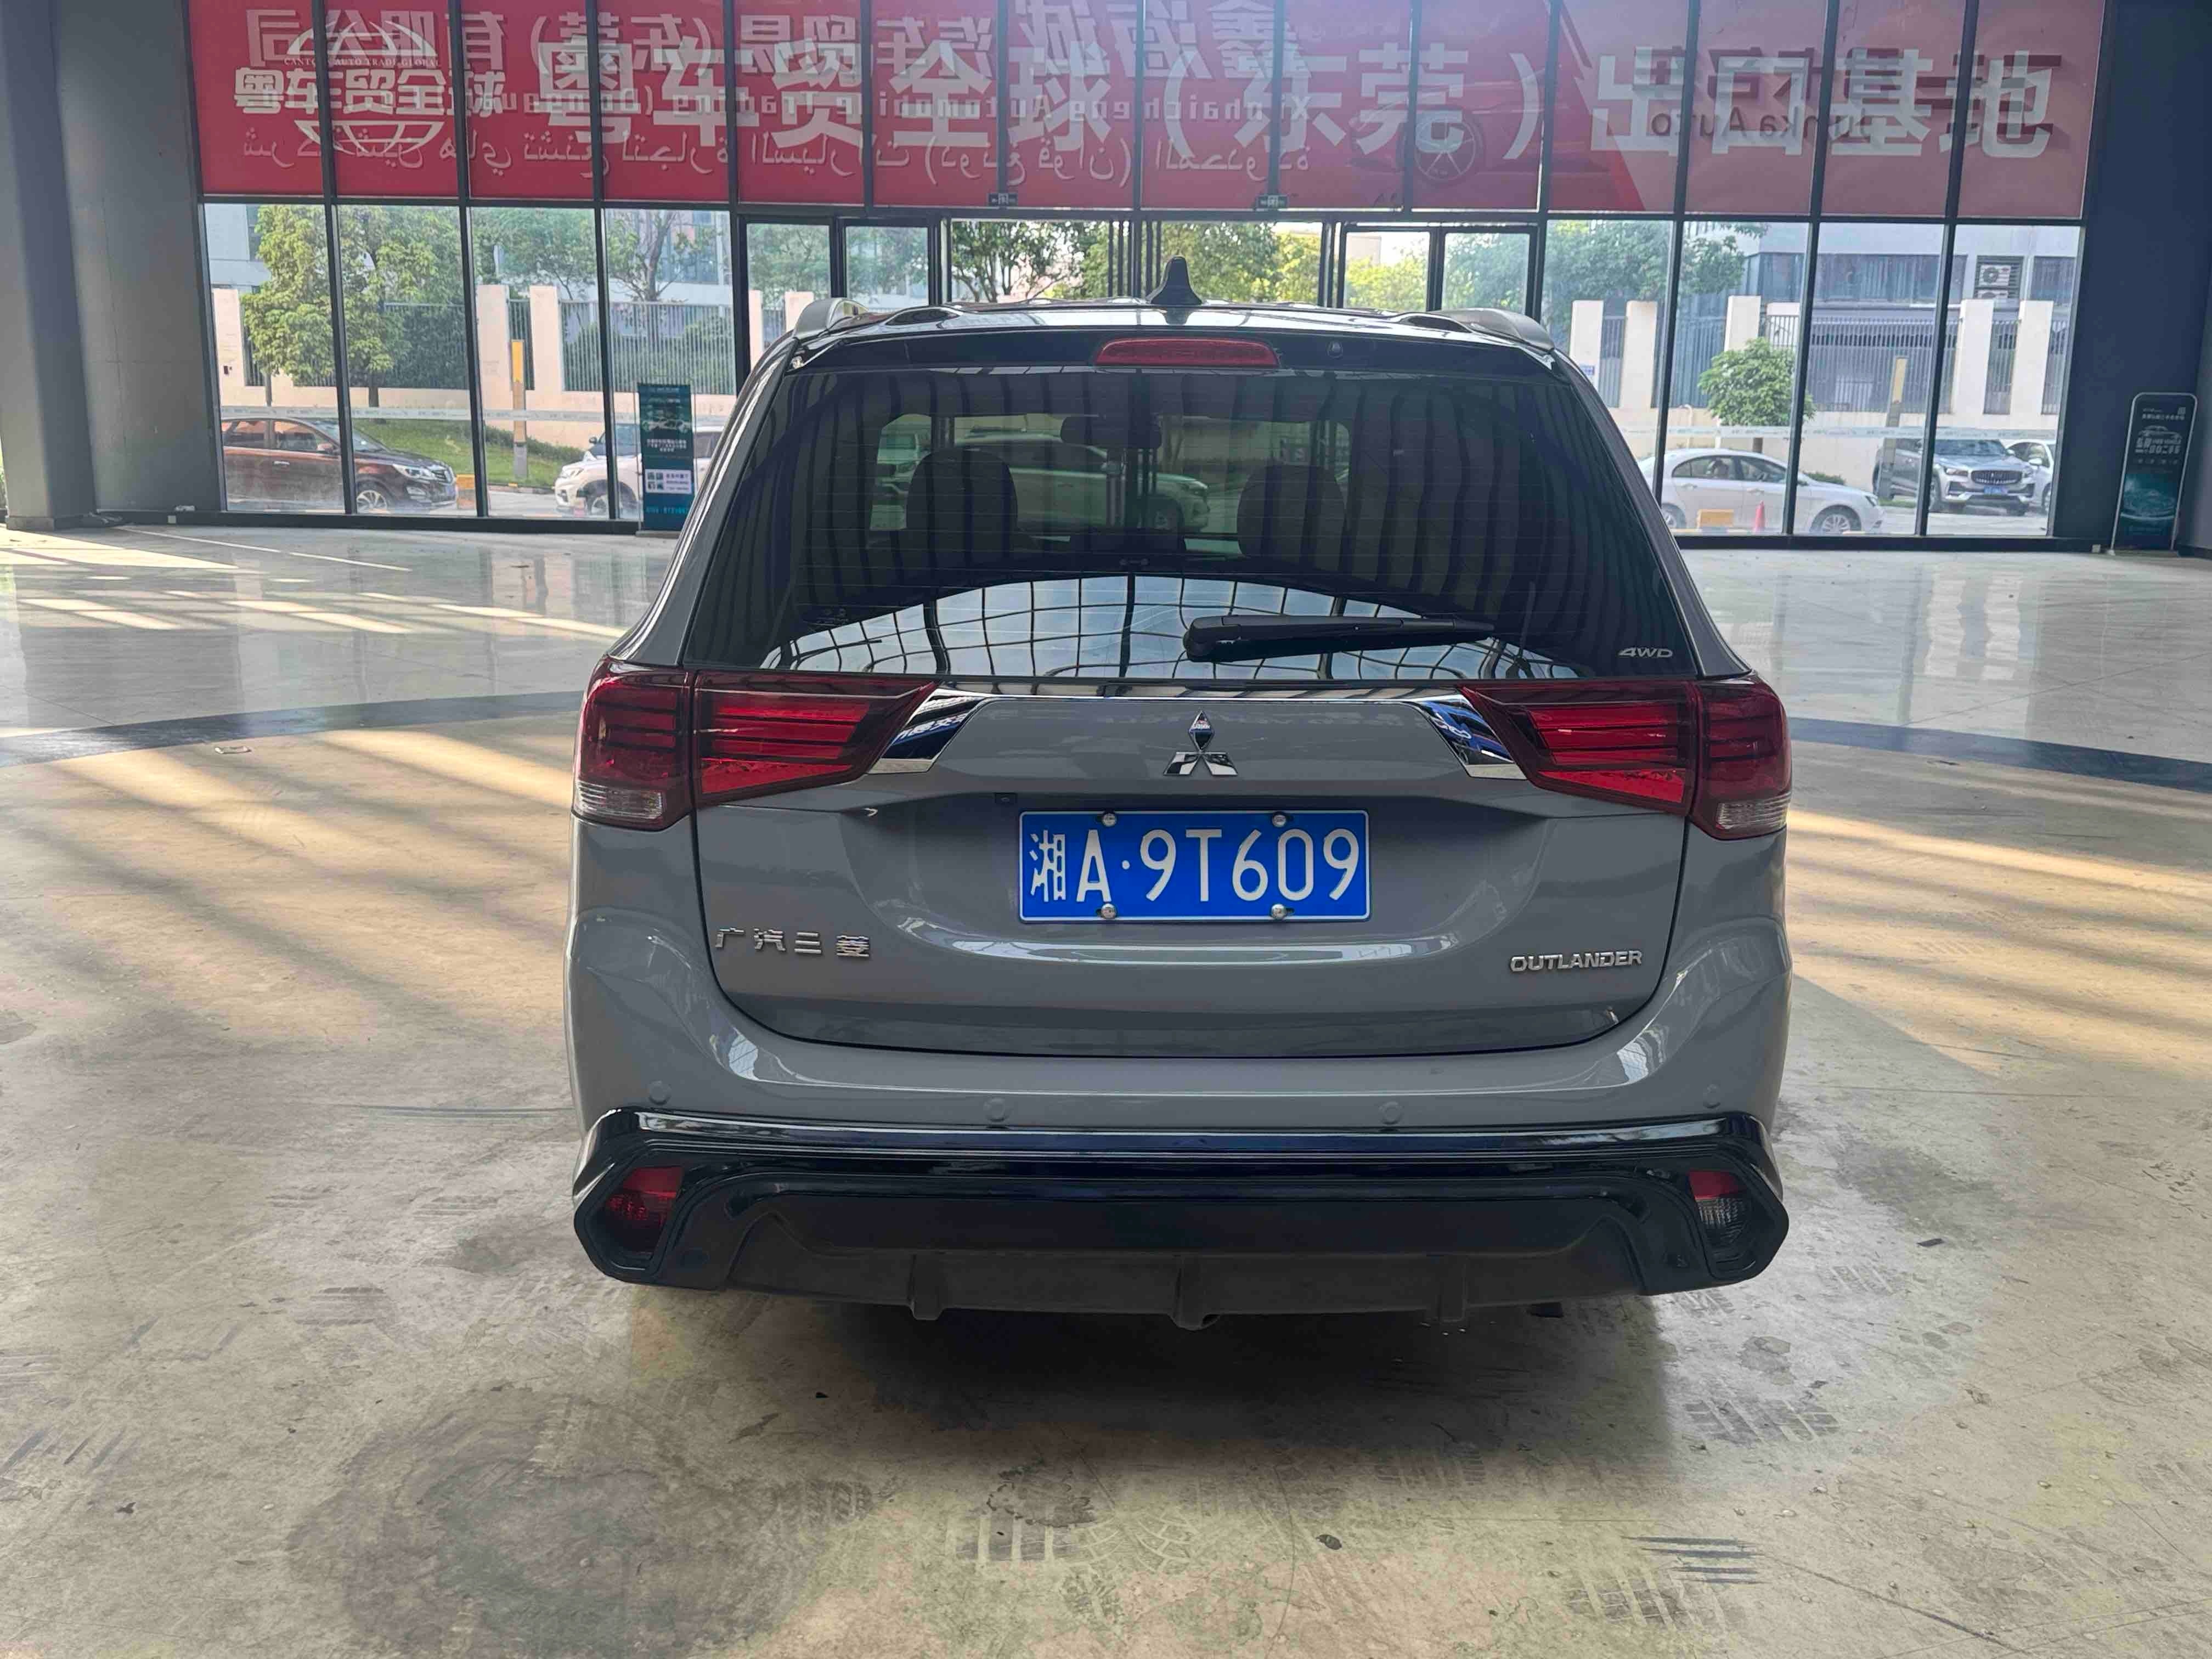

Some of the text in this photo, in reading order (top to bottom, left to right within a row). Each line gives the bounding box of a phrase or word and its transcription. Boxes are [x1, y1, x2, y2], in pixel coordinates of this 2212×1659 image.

[1619, 646, 1673, 658] 4WD
[1029, 828, 1360, 903] 湘A·9T609
[1510, 950, 1643, 972] OUTLANDER
